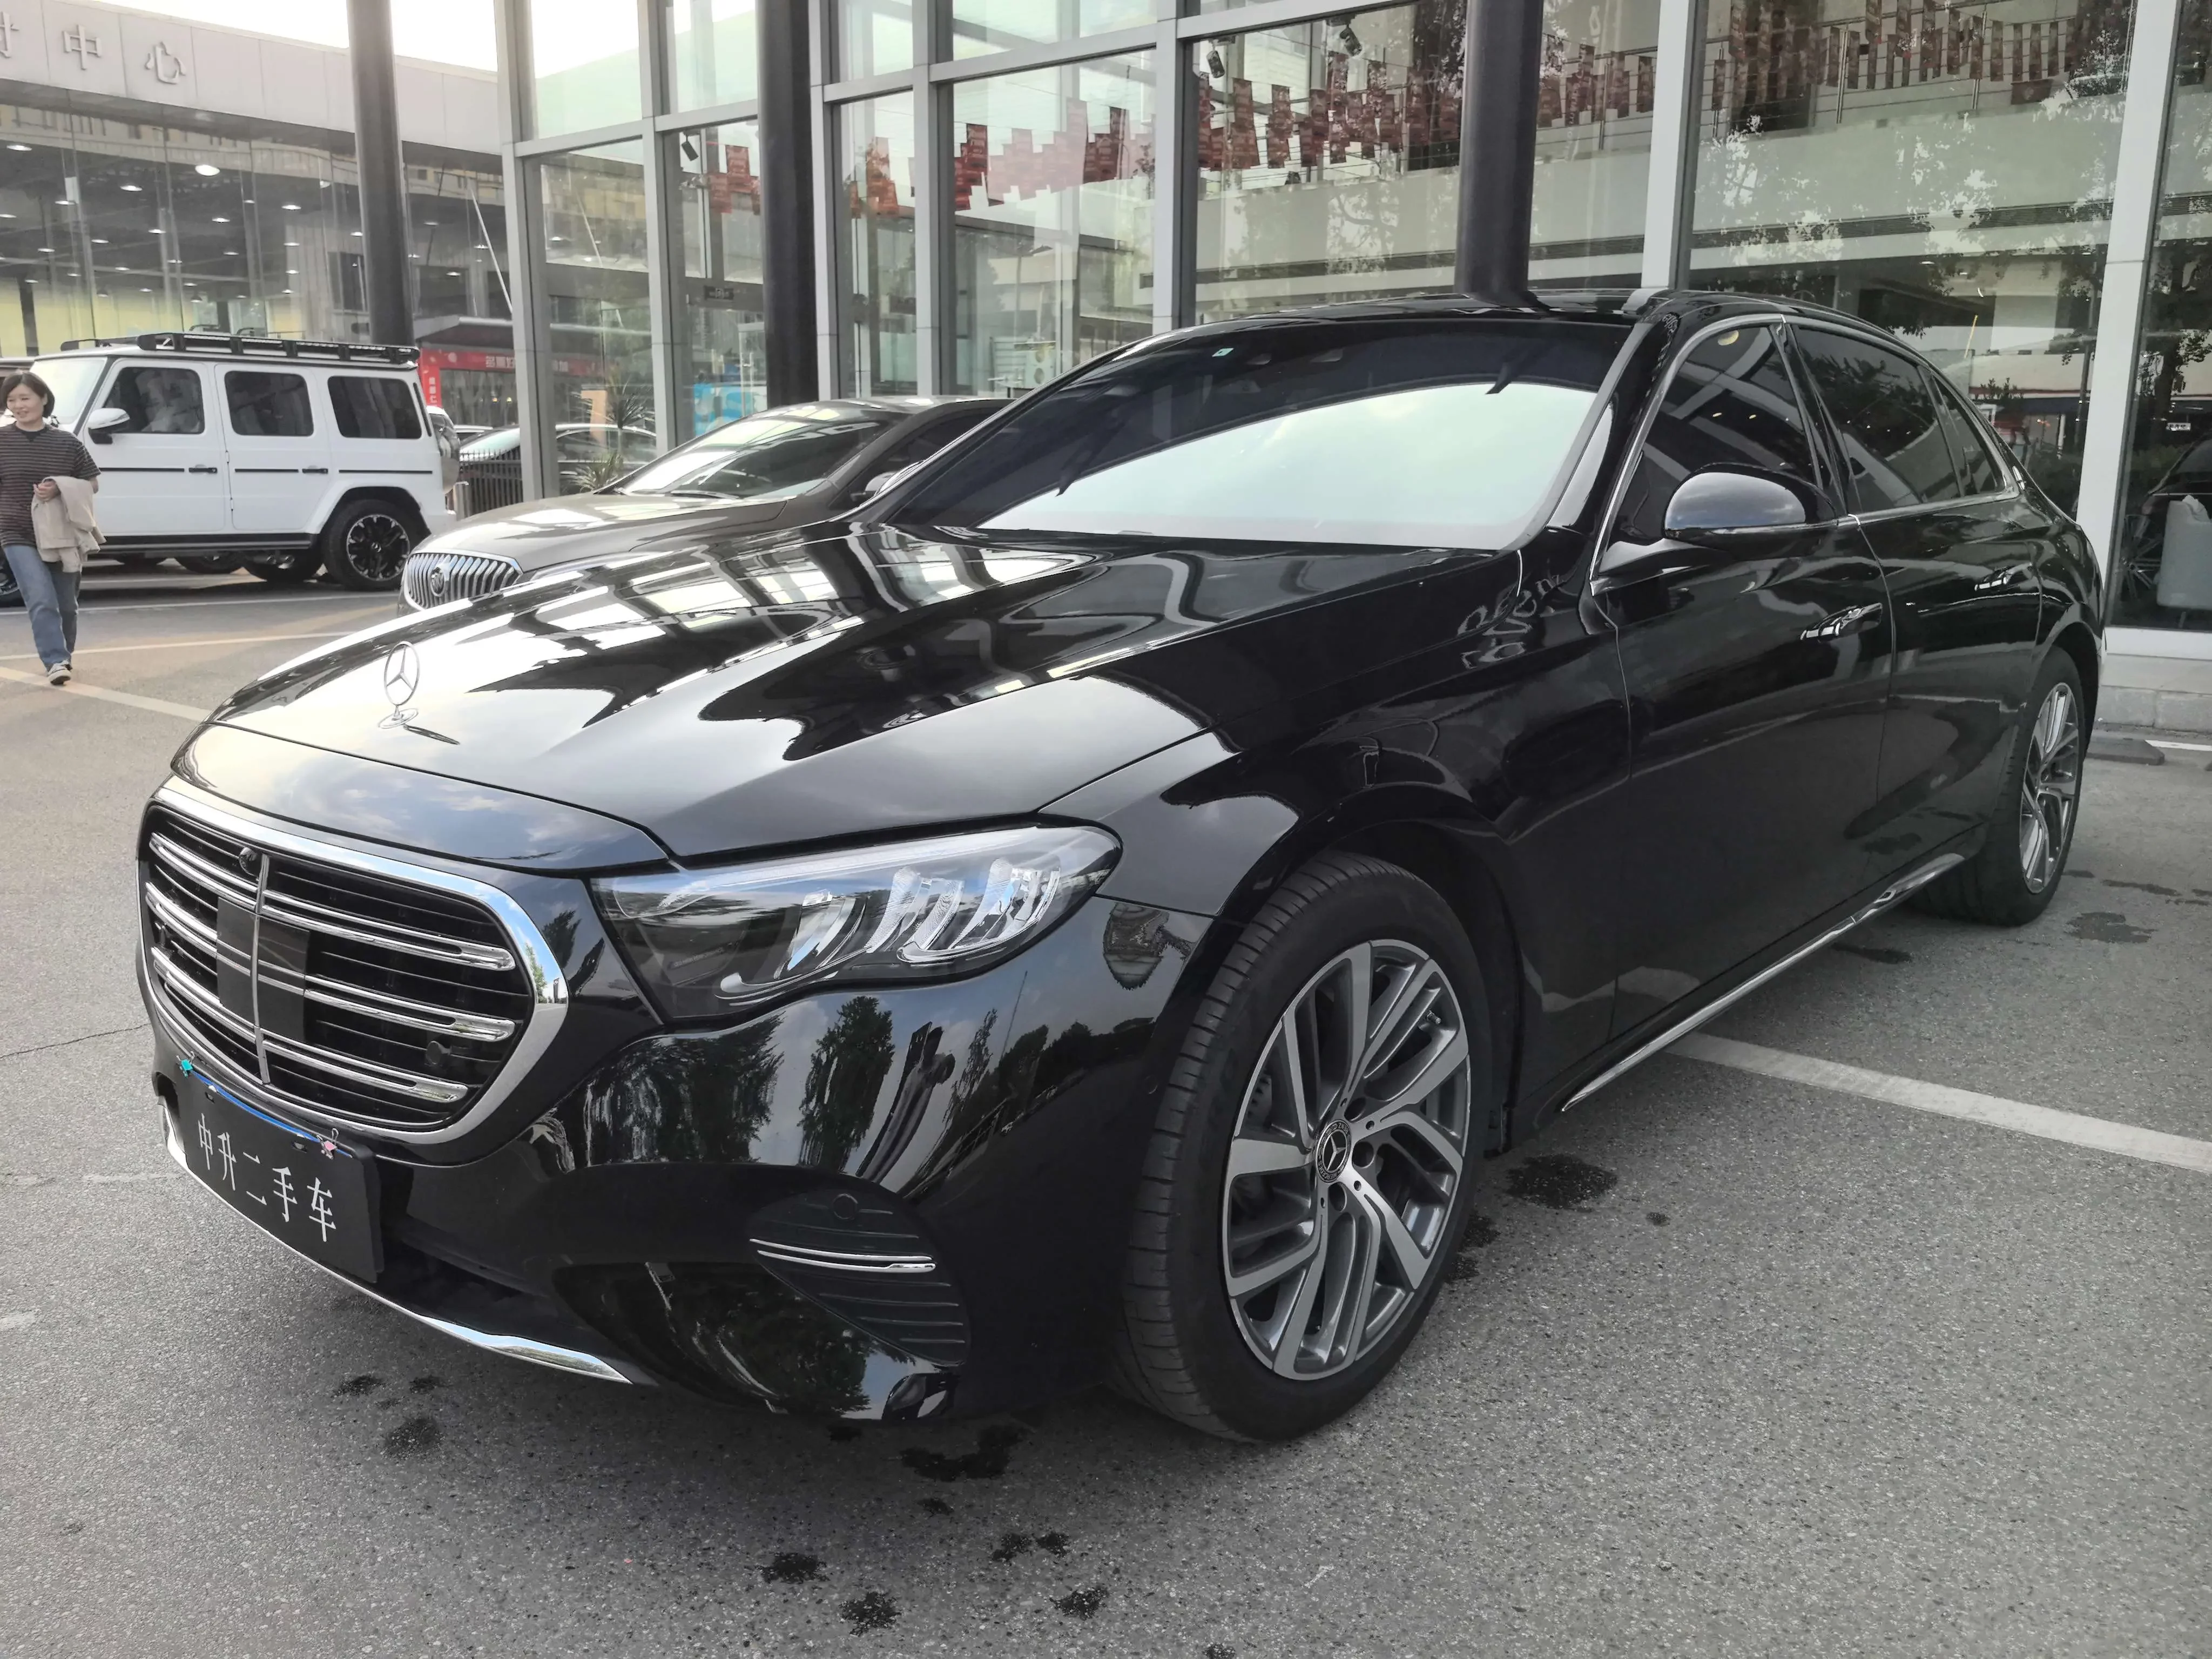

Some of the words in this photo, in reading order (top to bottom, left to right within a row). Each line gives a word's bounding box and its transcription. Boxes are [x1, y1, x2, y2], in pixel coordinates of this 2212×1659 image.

[198, 1112, 336, 1243] 中升二手车
